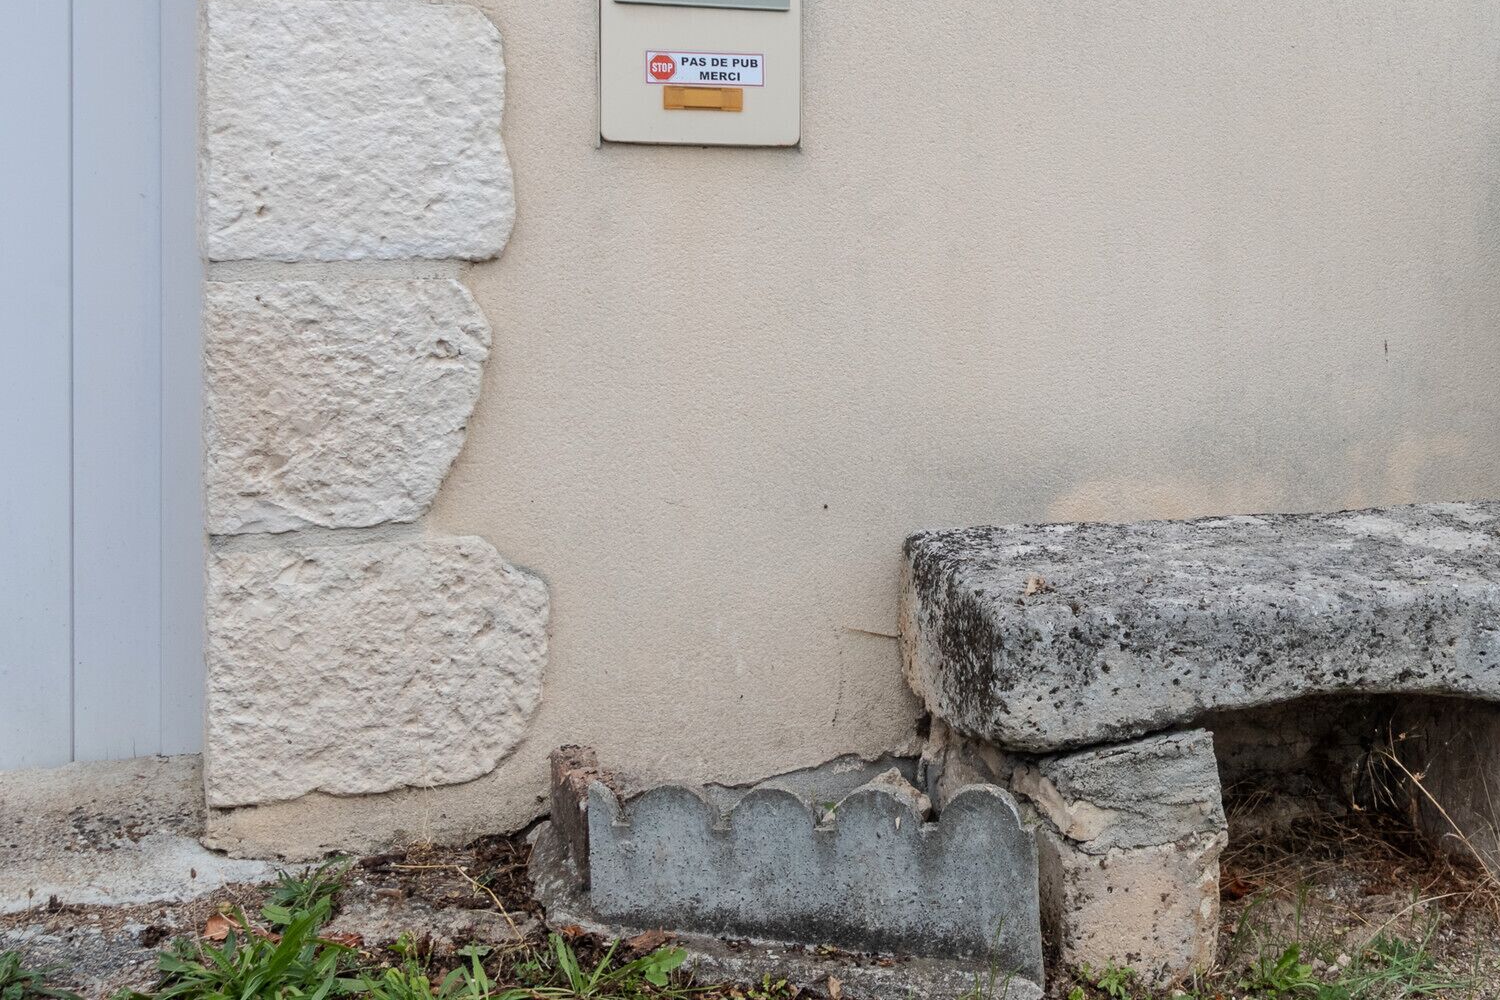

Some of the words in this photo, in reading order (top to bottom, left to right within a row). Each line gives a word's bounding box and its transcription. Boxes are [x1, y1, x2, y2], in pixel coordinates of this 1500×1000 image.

[651, 62, 673, 73] STOP
[681, 57, 706, 67] PAS
[711, 58, 728, 67] DE
[732, 59, 758, 68] PUB
[700, 71, 741, 81] MERCI
